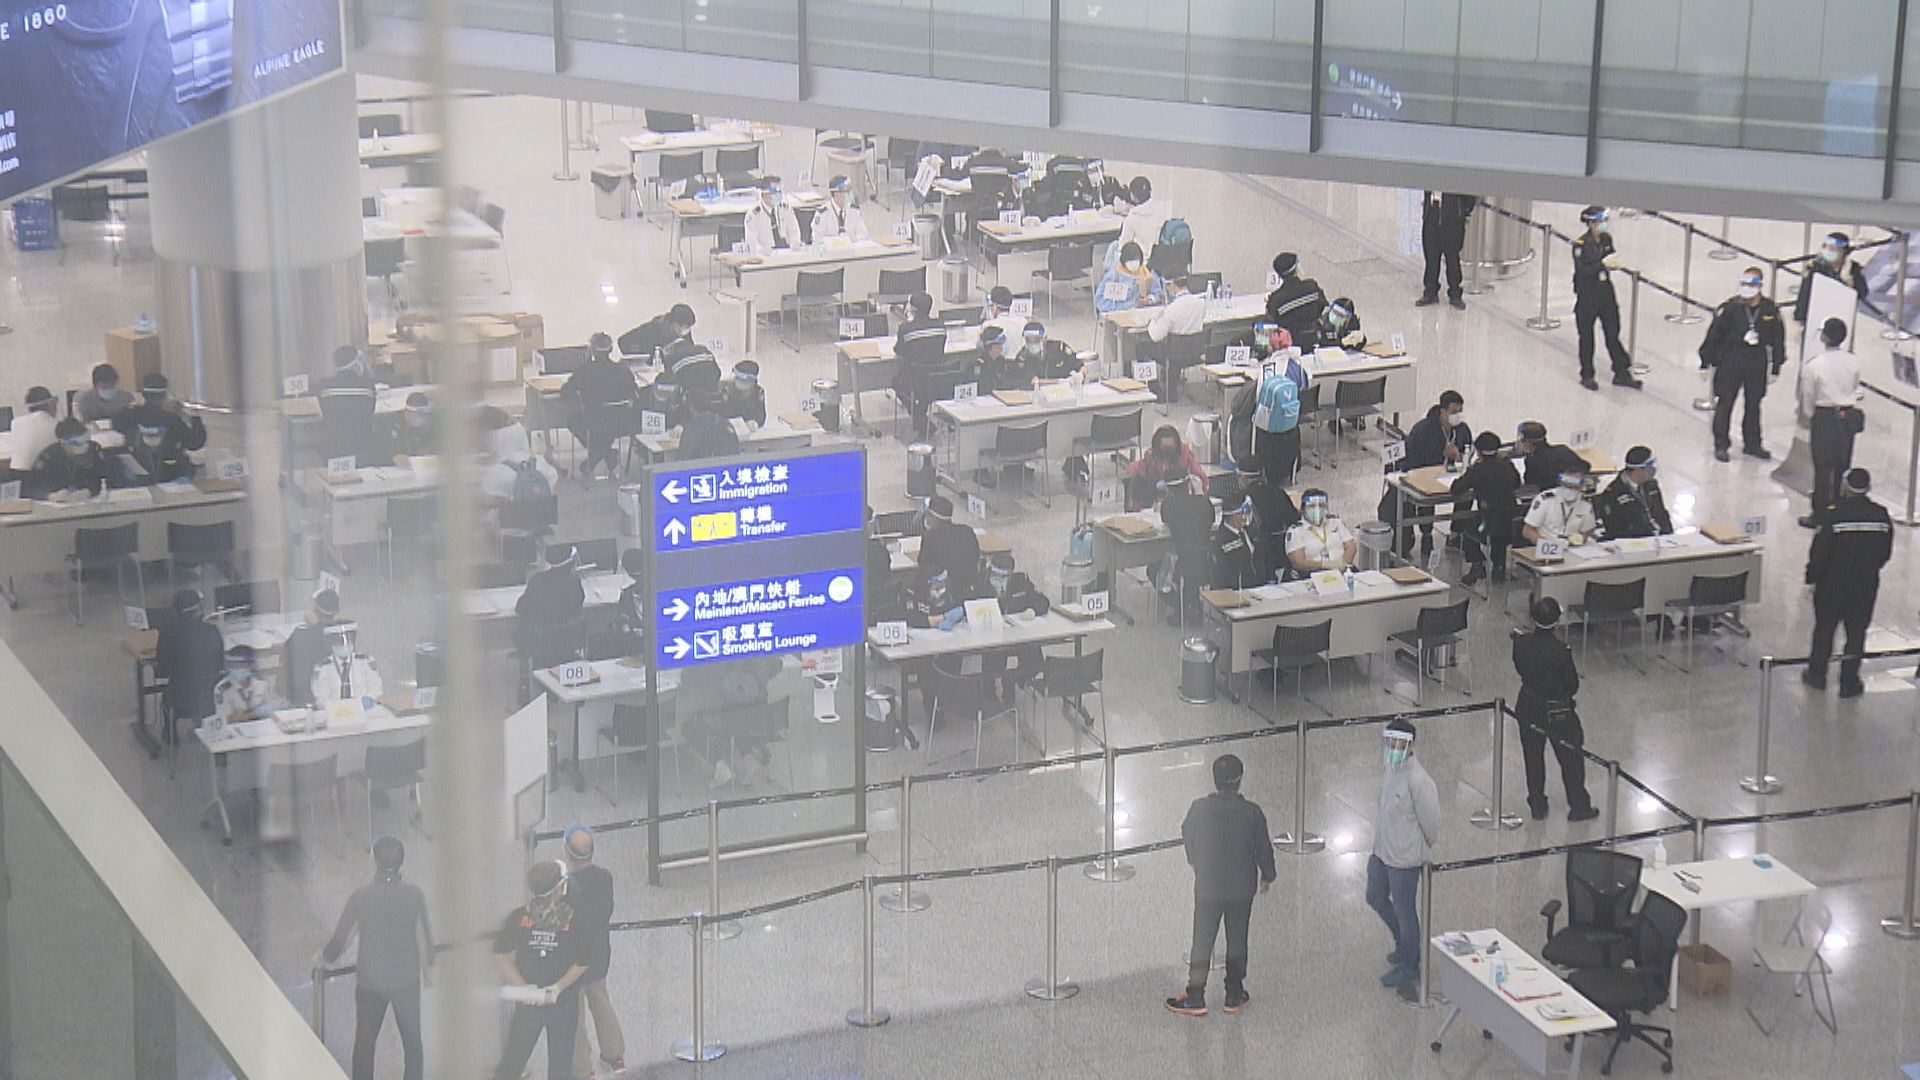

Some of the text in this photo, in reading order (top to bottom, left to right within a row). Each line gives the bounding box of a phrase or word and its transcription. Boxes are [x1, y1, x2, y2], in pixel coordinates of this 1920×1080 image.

[24, 4, 66, 32] 1860
[293, 39, 325, 63] EAGLE
[1013, 302, 1028, 313] 33
[845, 323, 859, 334] 34
[709, 340, 723, 350] 35
[1231, 350, 1245, 361] 22
[1139, 366, 1151, 378] 23
[959, 388, 972, 400] 24
[802, 400, 816, 412] 25
[646, 416, 660, 427] 26
[1387, 446, 1400, 459] 12
[719, 482, 788, 499] Immigration
[740, 520, 786, 537] Transfer
[1541, 543, 1558, 555] 02
[694, 594, 826, 621] Mainland/Macao Ferries
[1087, 598, 1103, 611] 05
[883, 627, 900, 639] 06
[722, 633, 817, 655] Smoking Lounge
[566, 667, 583, 680] 08
